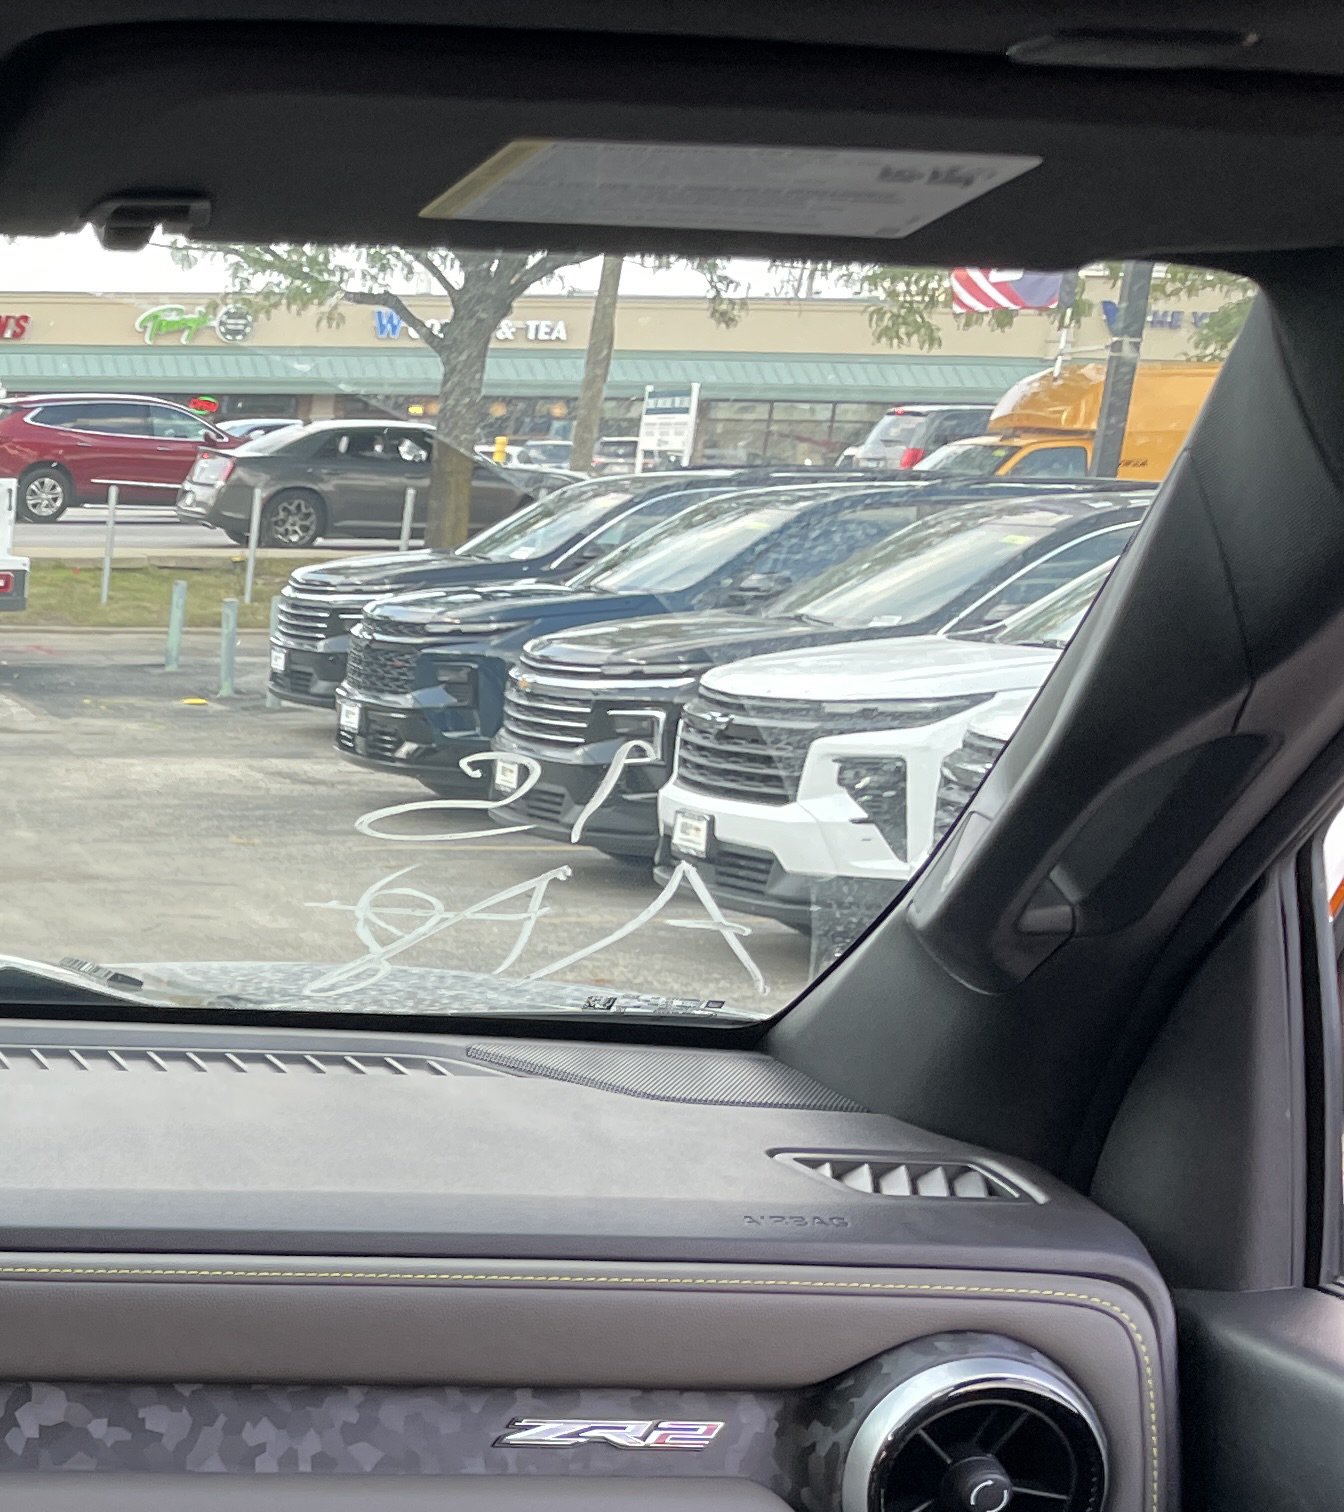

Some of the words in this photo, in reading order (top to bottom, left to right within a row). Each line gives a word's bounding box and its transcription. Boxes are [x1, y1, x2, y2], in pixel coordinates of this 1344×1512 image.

[496, 319, 516, 340] &
[525, 319, 568, 341] TEA
[497, 1418, 725, 1451] ZR2
